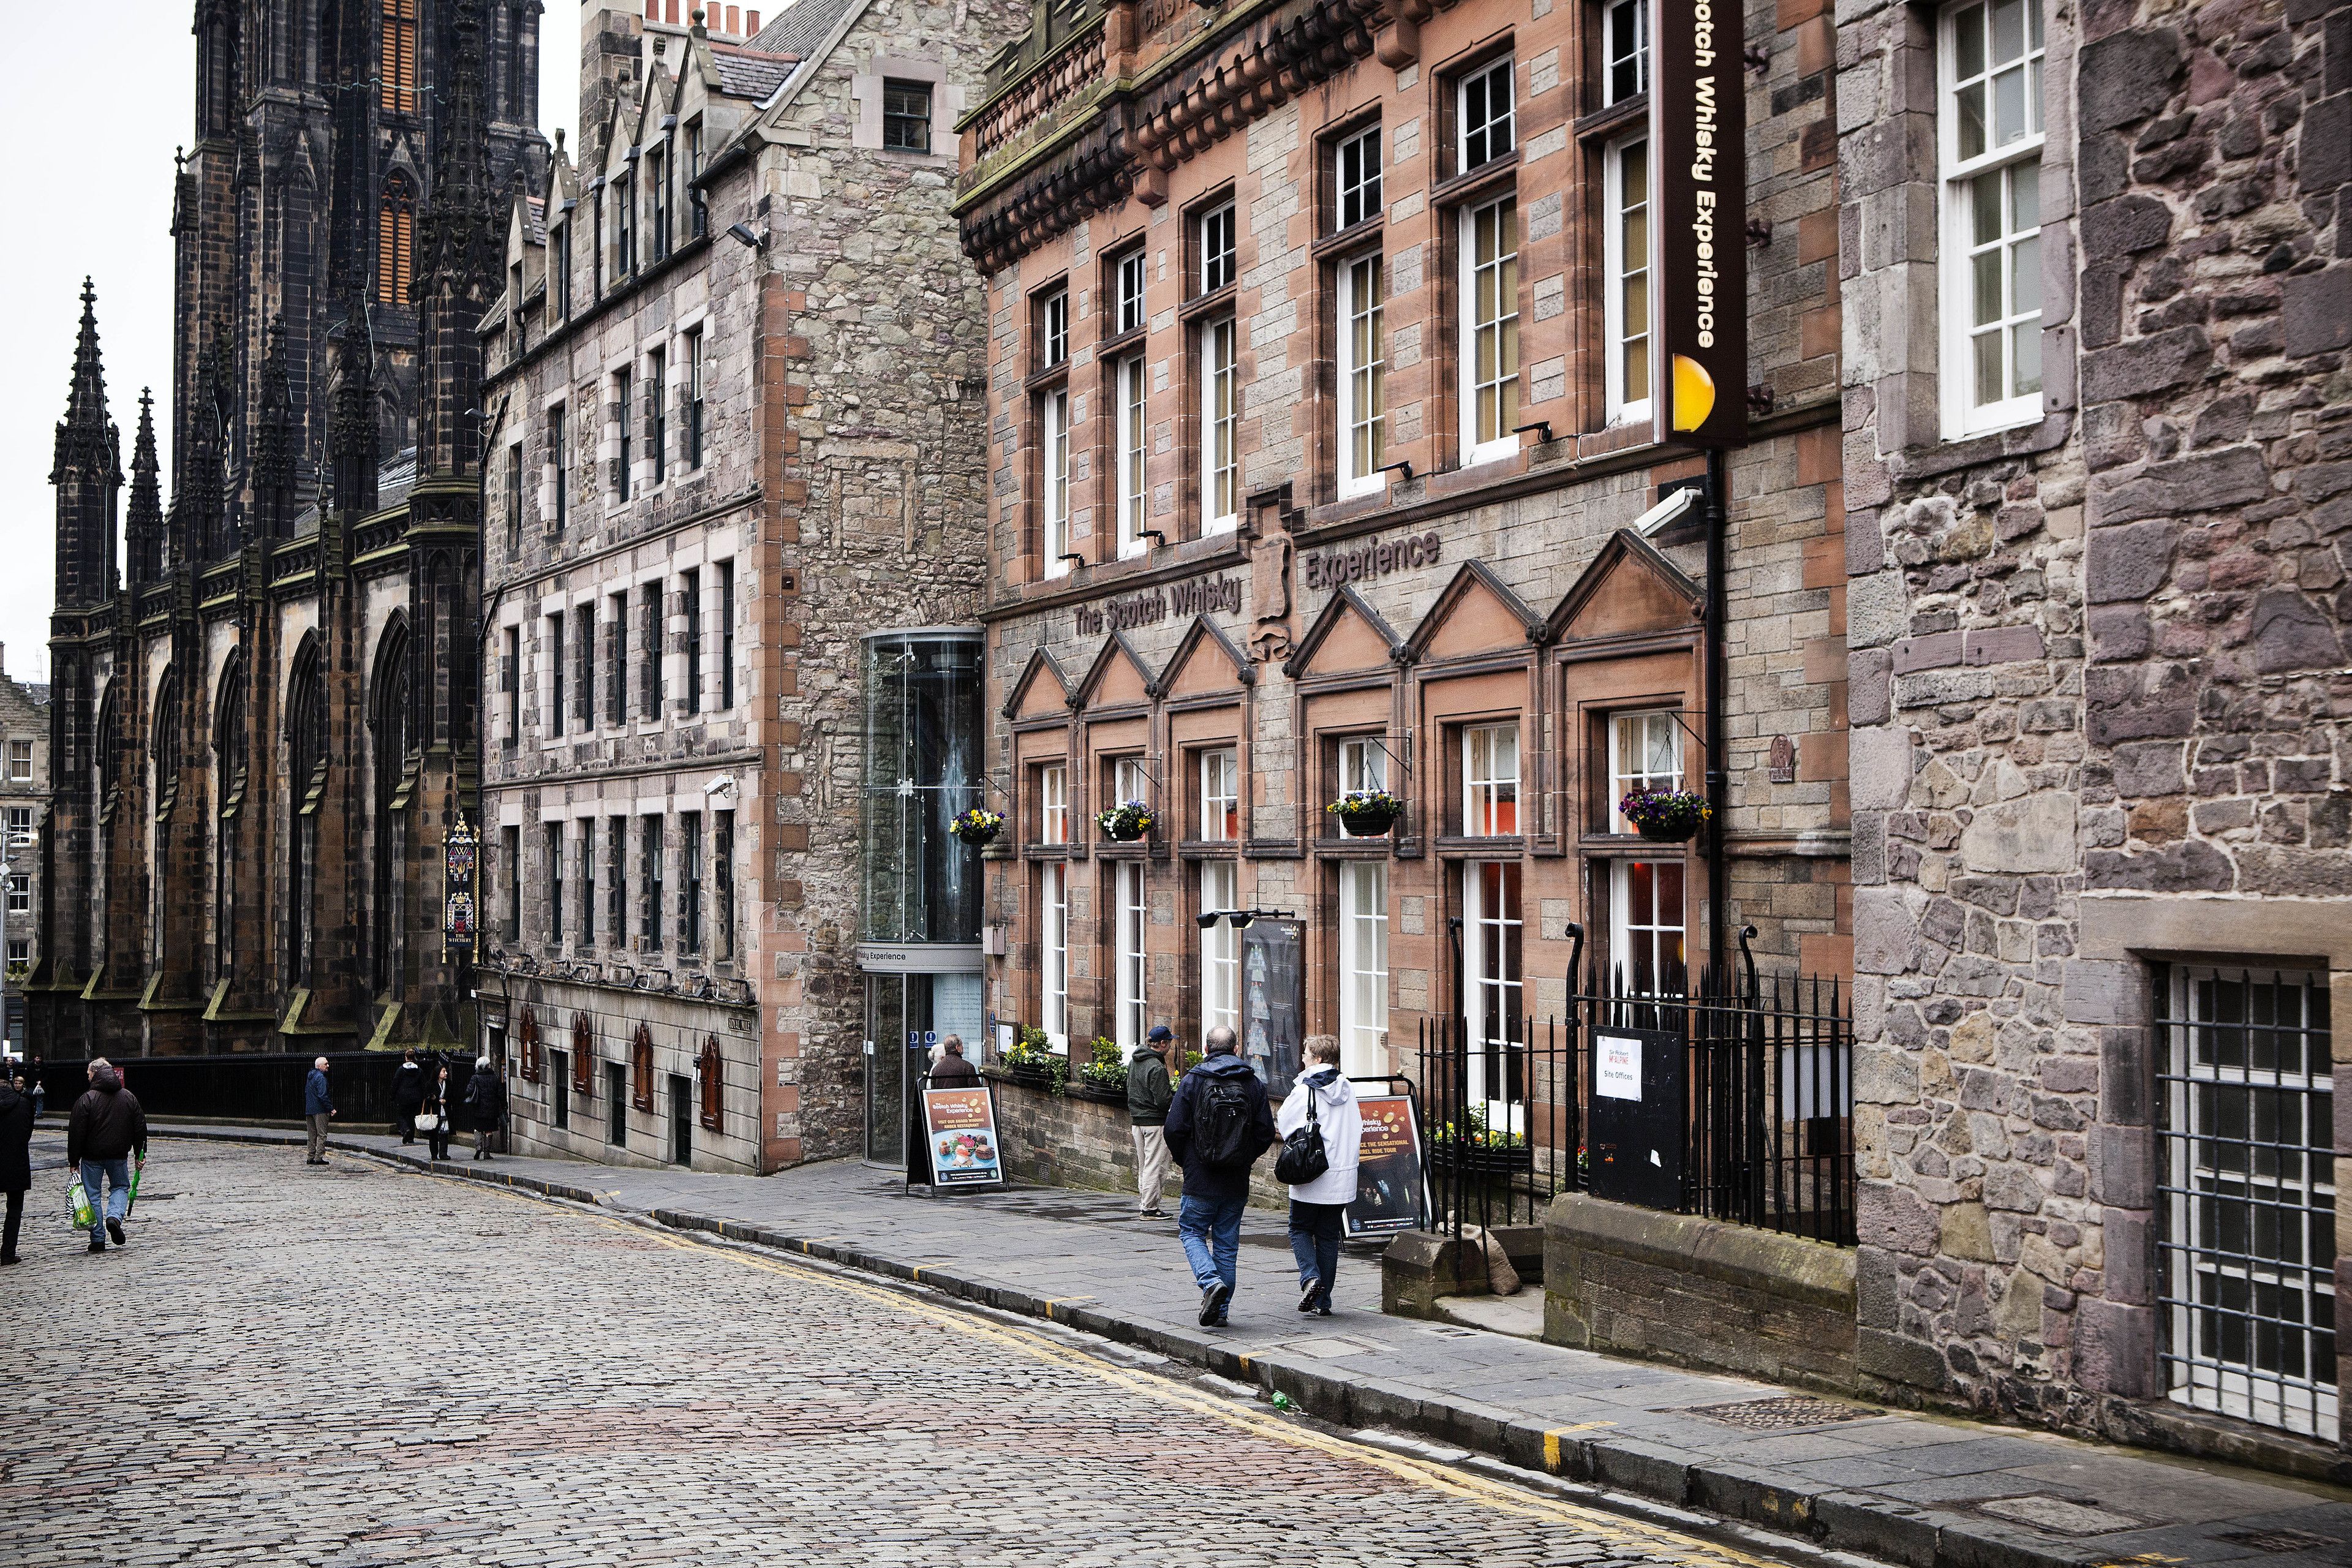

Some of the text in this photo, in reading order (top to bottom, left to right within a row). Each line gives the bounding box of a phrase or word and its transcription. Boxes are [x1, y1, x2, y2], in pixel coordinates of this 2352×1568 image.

[1692, 0, 1718, 349] otch Whisky Experience
[1074, 532, 1441, 636] The Scotch Whisky Experience
[870, 952, 906, 961] Experience
[729, 1018, 750, 1031] ROYAL MILE
[1615, 1071, 1633, 1080] Offices
